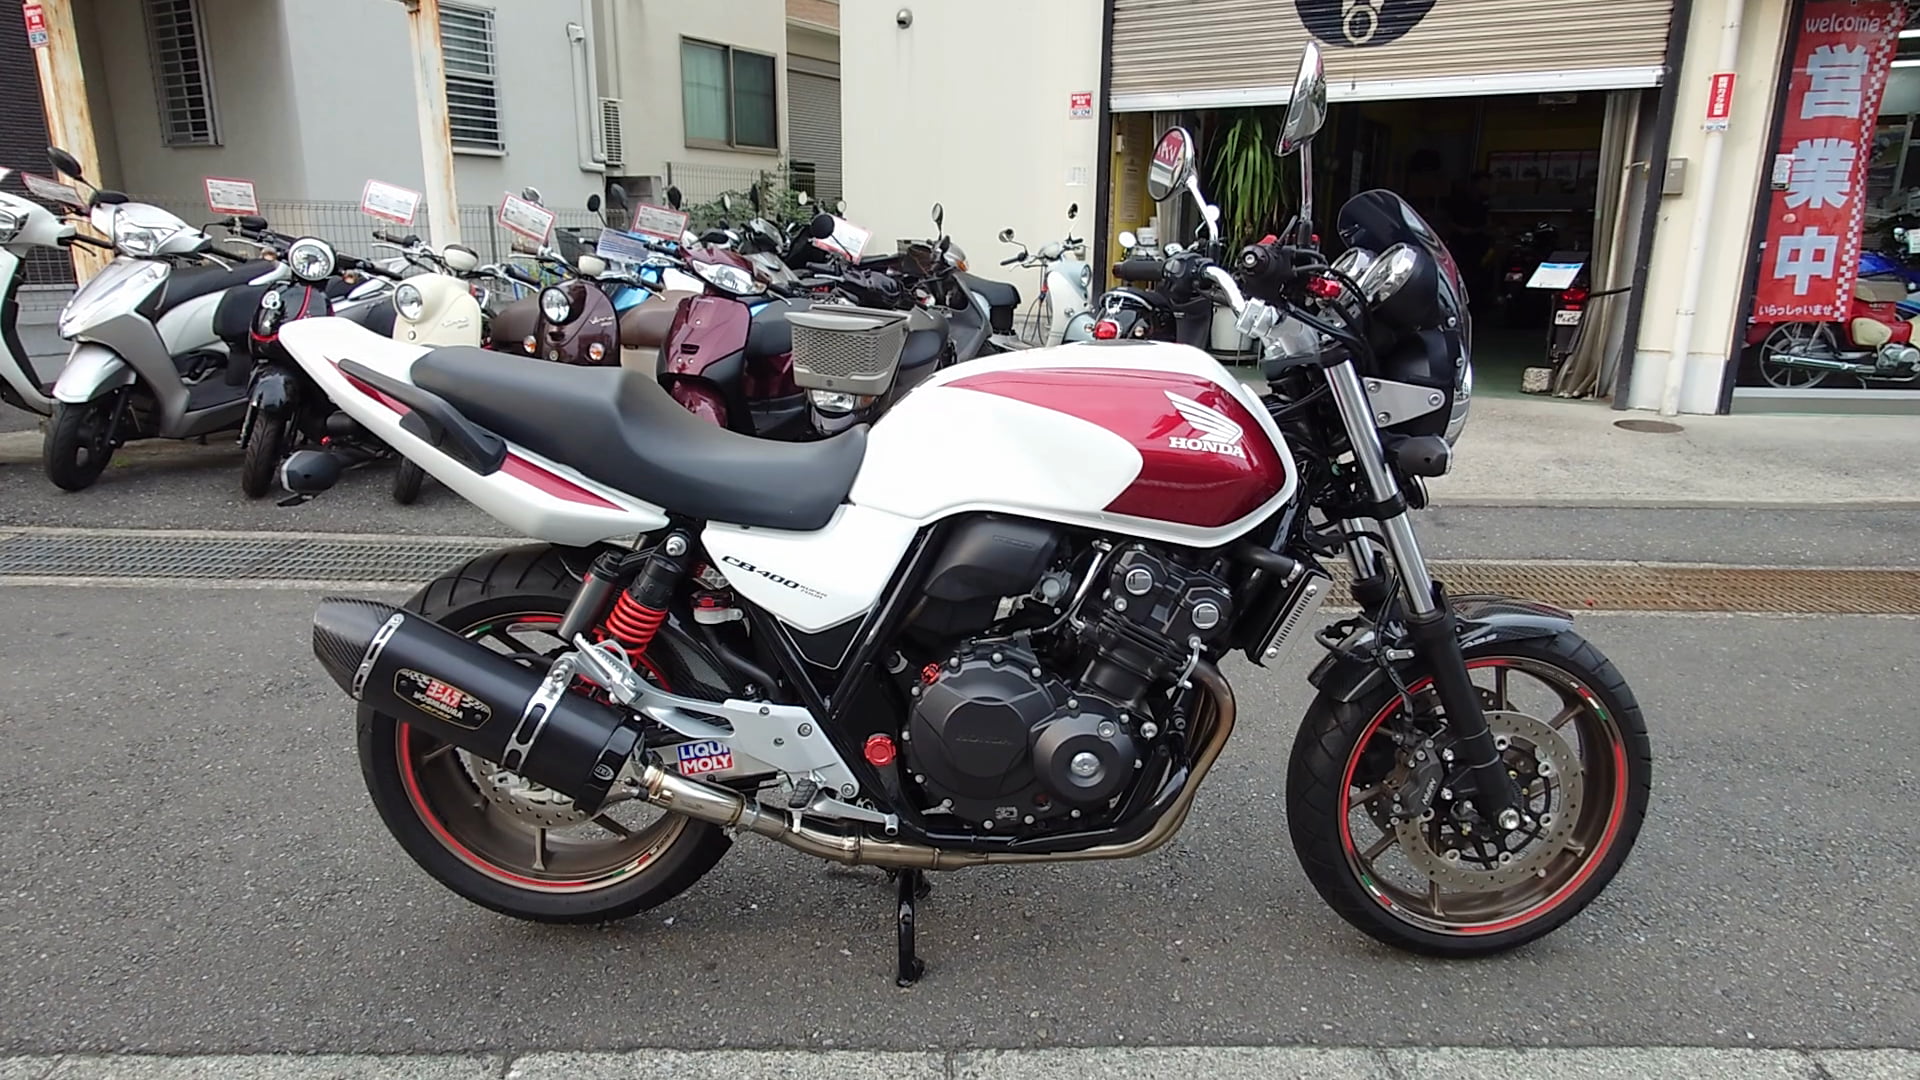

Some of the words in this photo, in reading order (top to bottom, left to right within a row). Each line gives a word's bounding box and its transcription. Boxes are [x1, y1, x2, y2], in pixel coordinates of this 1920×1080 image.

[1805, 13, 1880, 33] welcome
[1773, 43, 1870, 295] 営業中
[1758, 304, 1834, 317] いらっしゃいませ
[1168, 436, 1246, 459] HONDA
[721, 555, 800, 589] CB400
[412, 690, 464, 719] YOSHIMURA
[679, 741, 729, 760] LIQUI
[682, 754, 731, 775] MOLY
